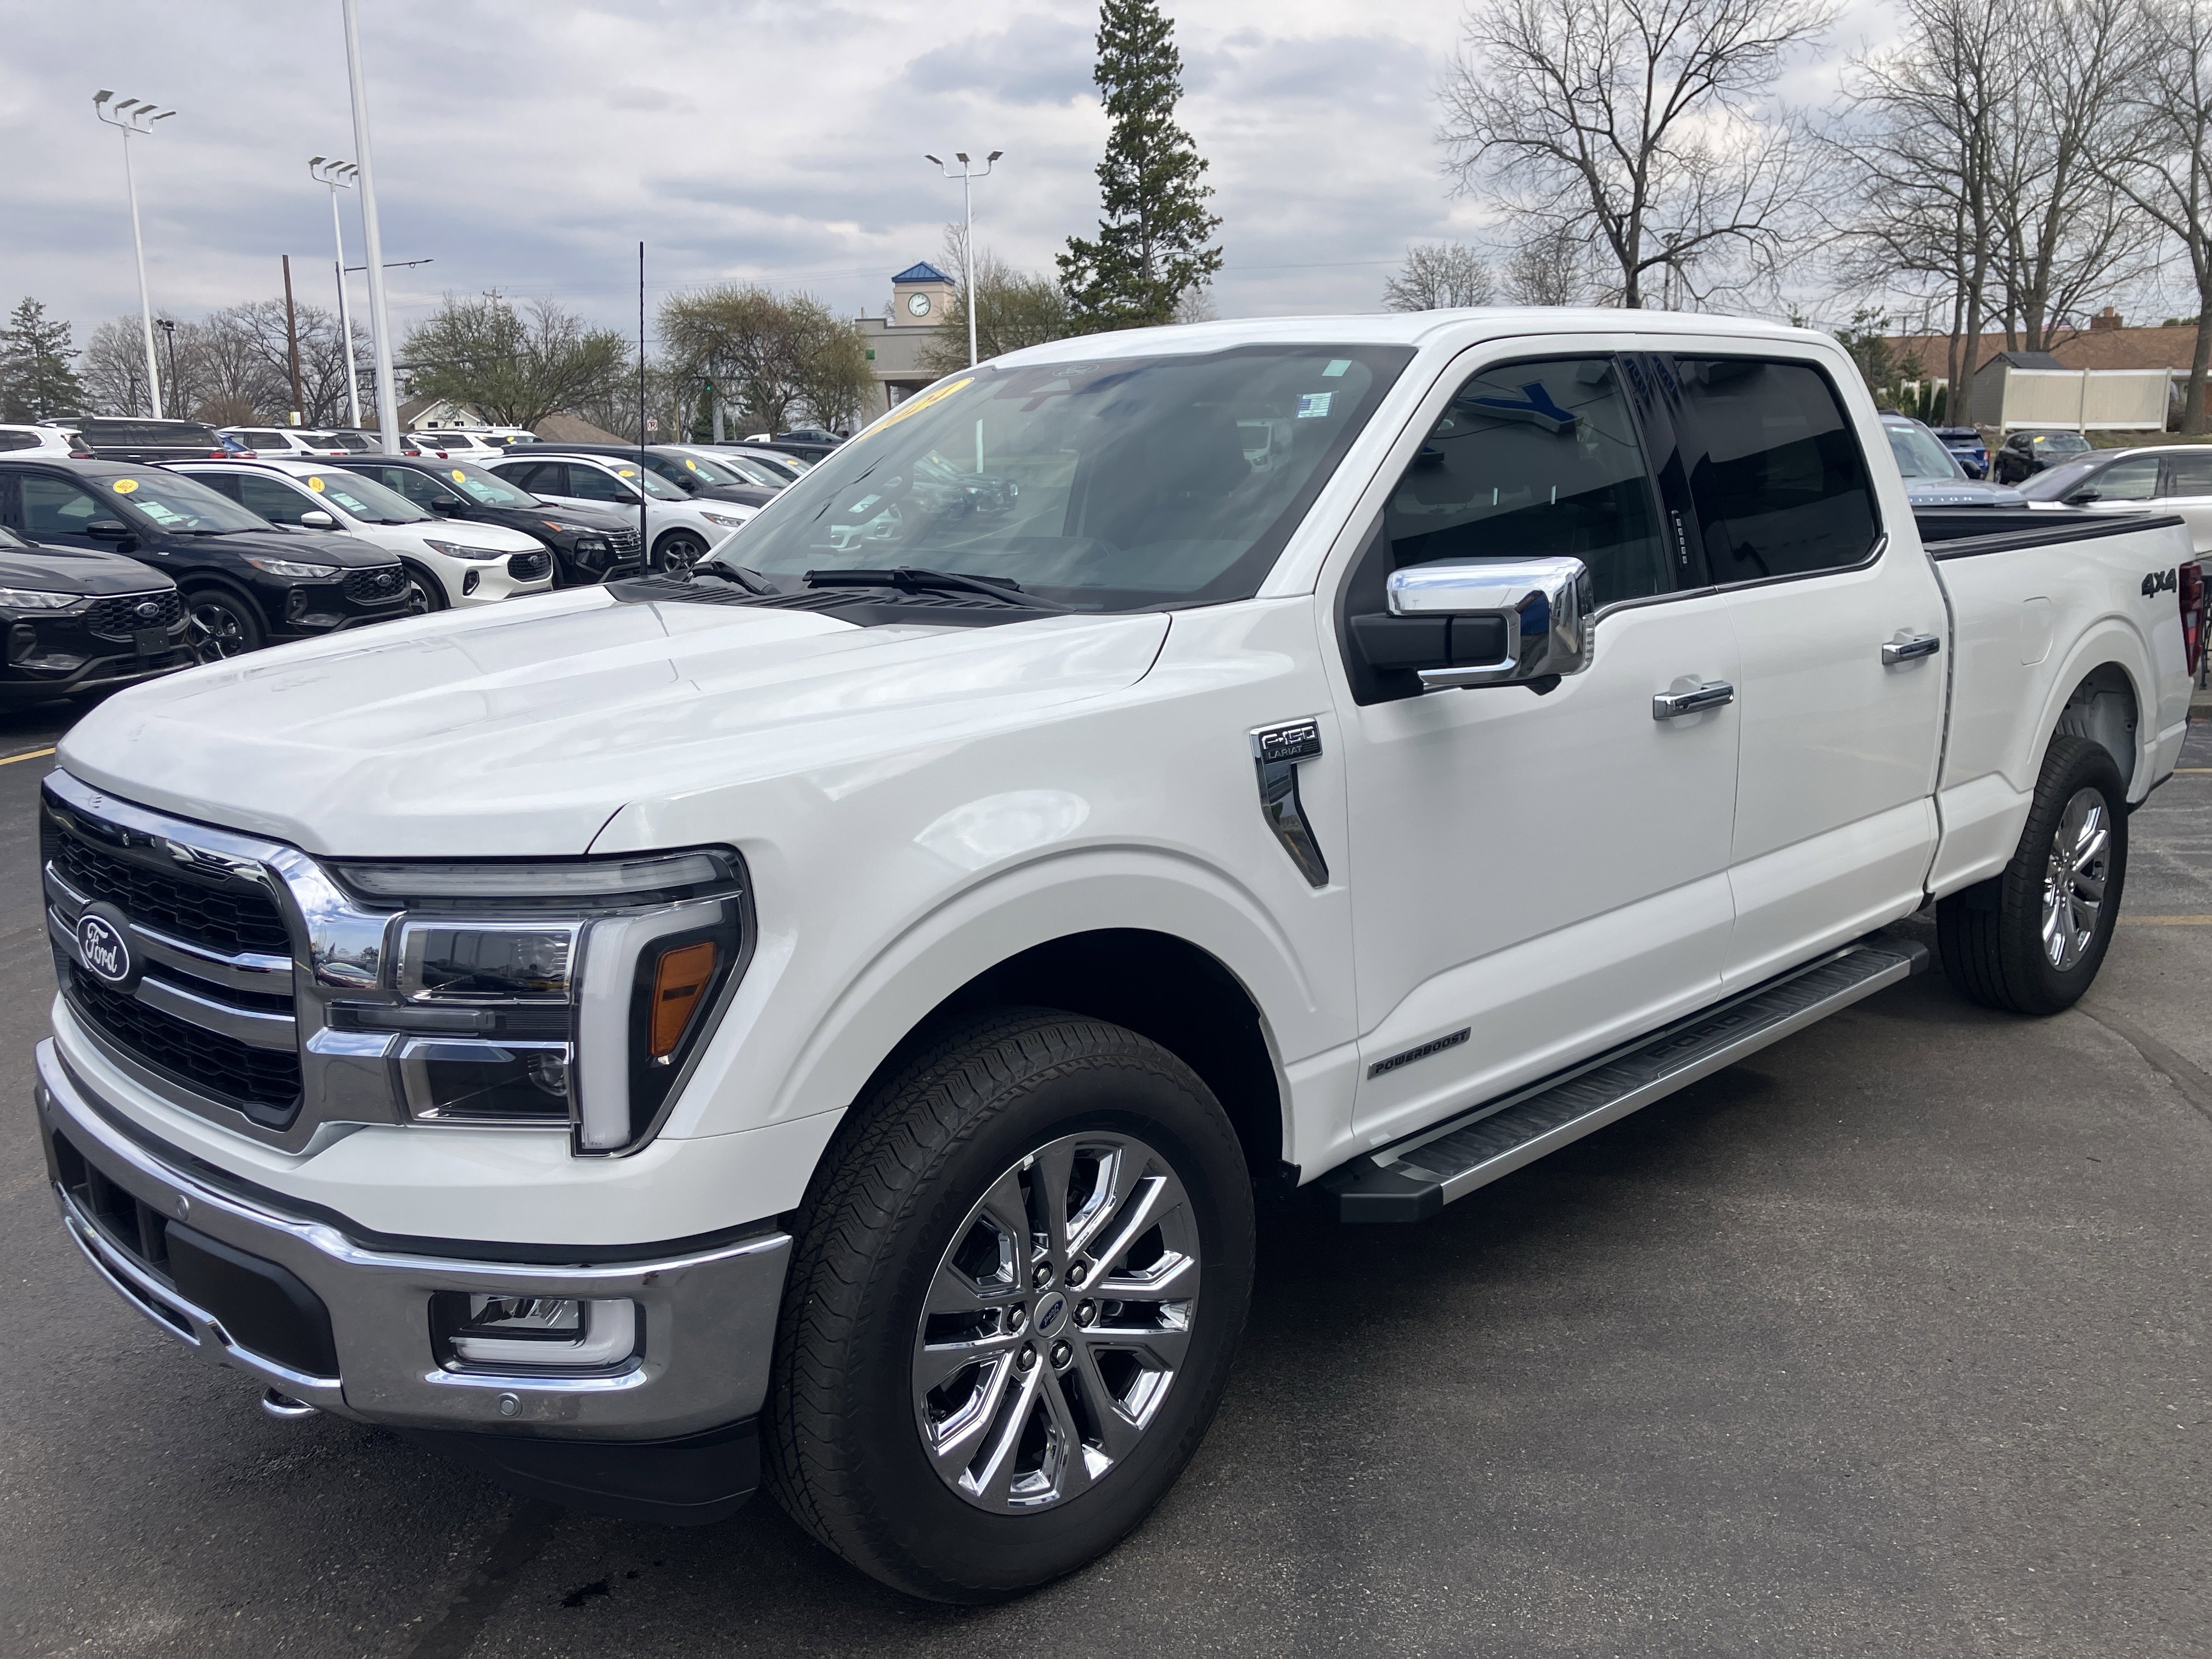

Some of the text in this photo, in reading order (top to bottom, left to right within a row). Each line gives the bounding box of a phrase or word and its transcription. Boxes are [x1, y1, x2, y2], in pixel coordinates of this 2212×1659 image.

[1262, 726, 1316, 749] F-150
[1268, 745, 1302, 759] LARIAT
[85, 922, 117, 973] Ford
[1375, 1031, 1467, 1074] POWERBOOST
[1044, 1304, 1059, 1325] Ford
